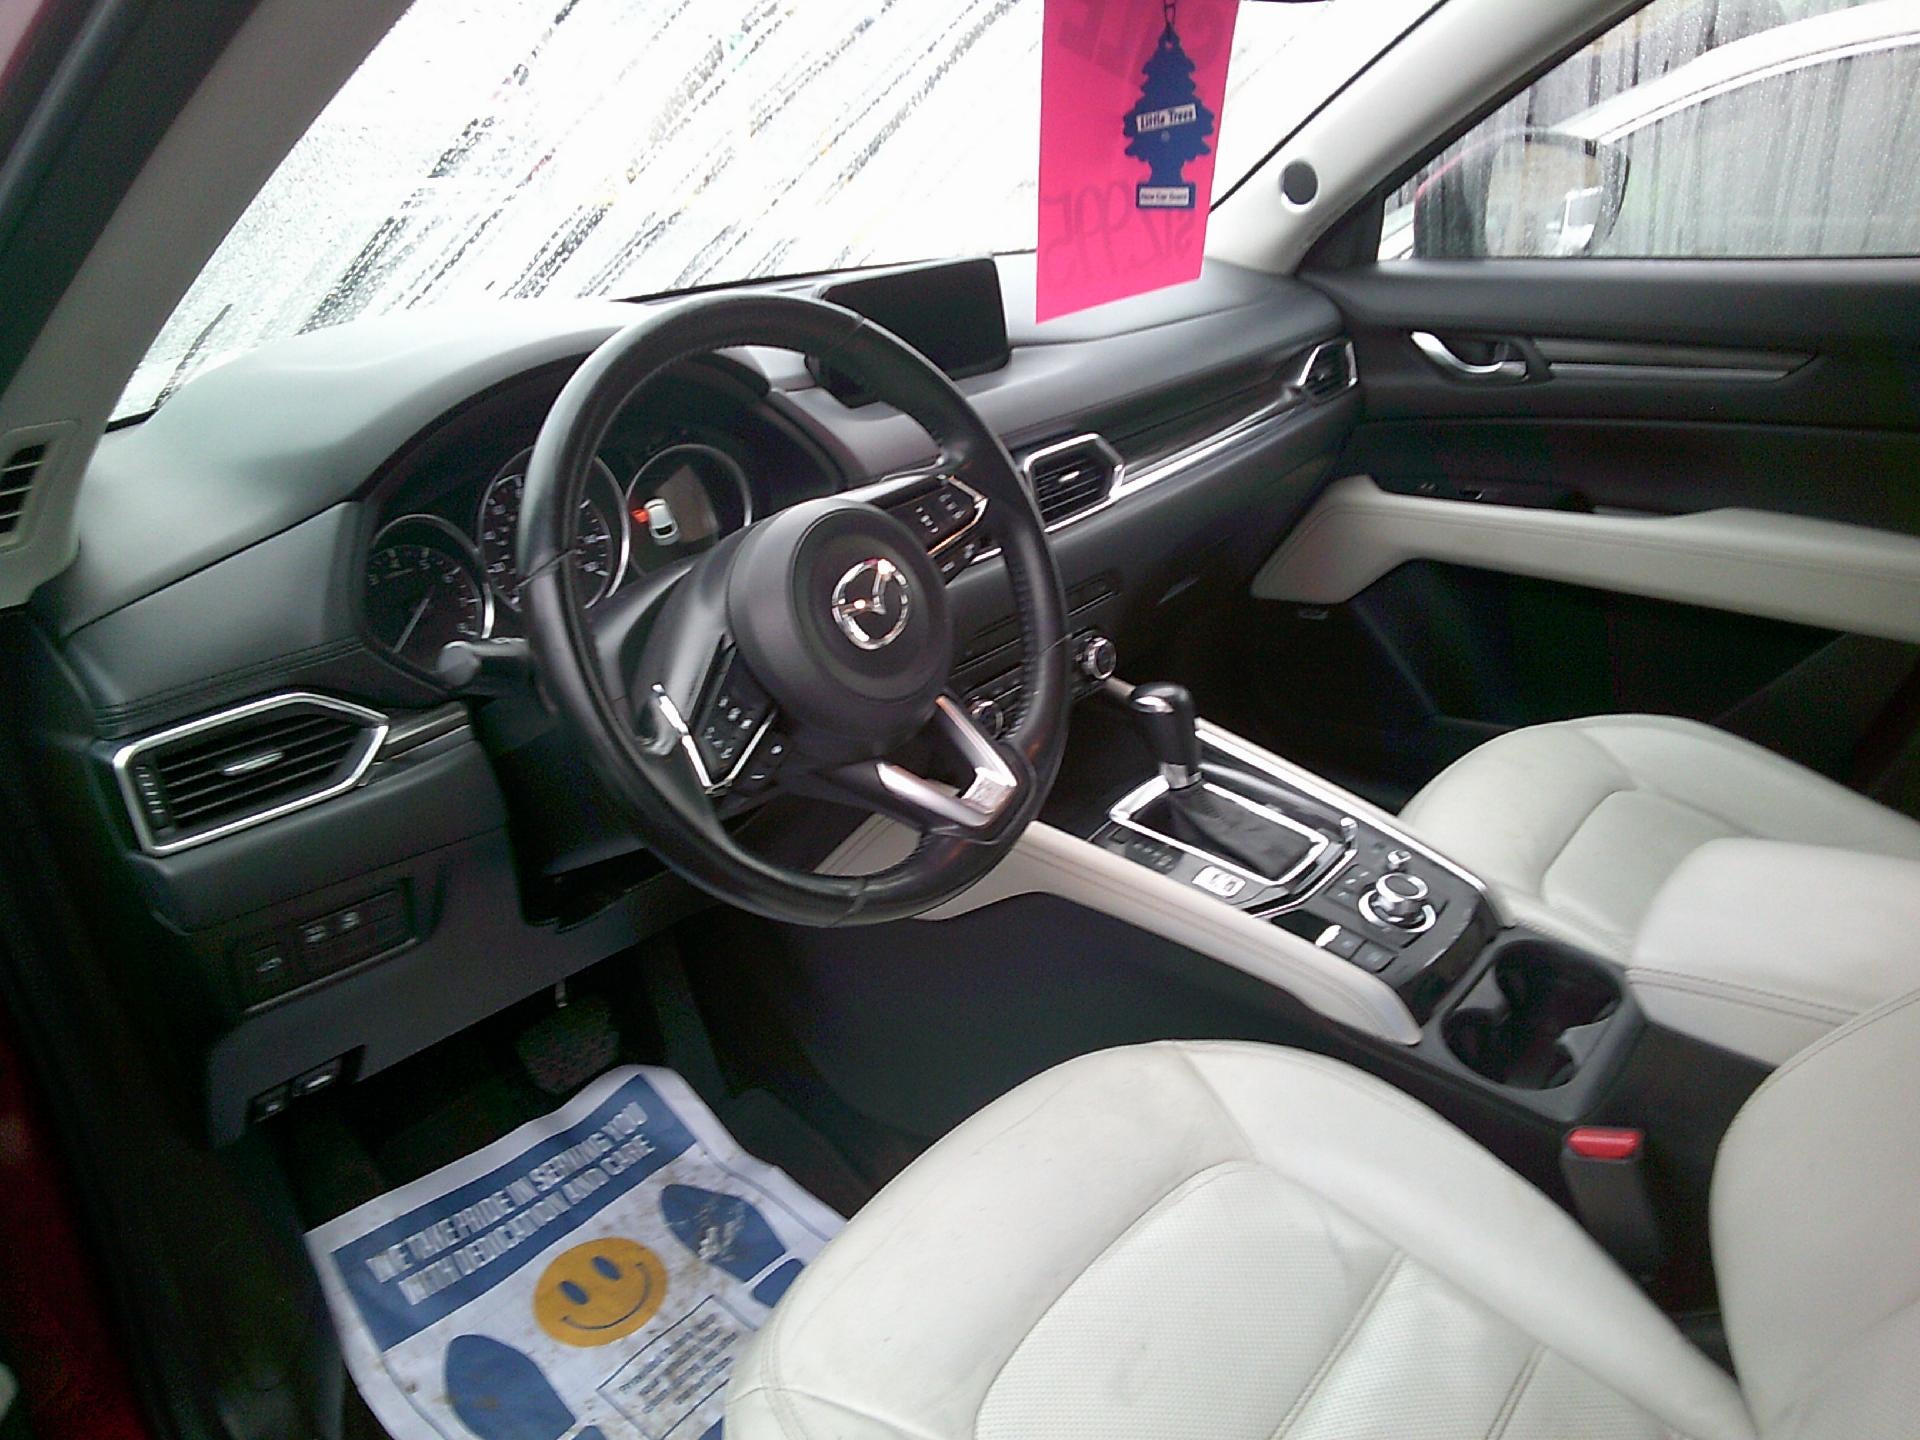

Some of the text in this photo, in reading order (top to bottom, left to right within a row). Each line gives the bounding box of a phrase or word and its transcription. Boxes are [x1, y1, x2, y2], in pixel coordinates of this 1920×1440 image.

[1140, 107, 1194, 129] Little Trees
[365, 1101, 648, 1283] WE TAKE PRIDE IN SERVING YOU
[398, 1134, 656, 1306] WITH DEDICATION AND CARE
